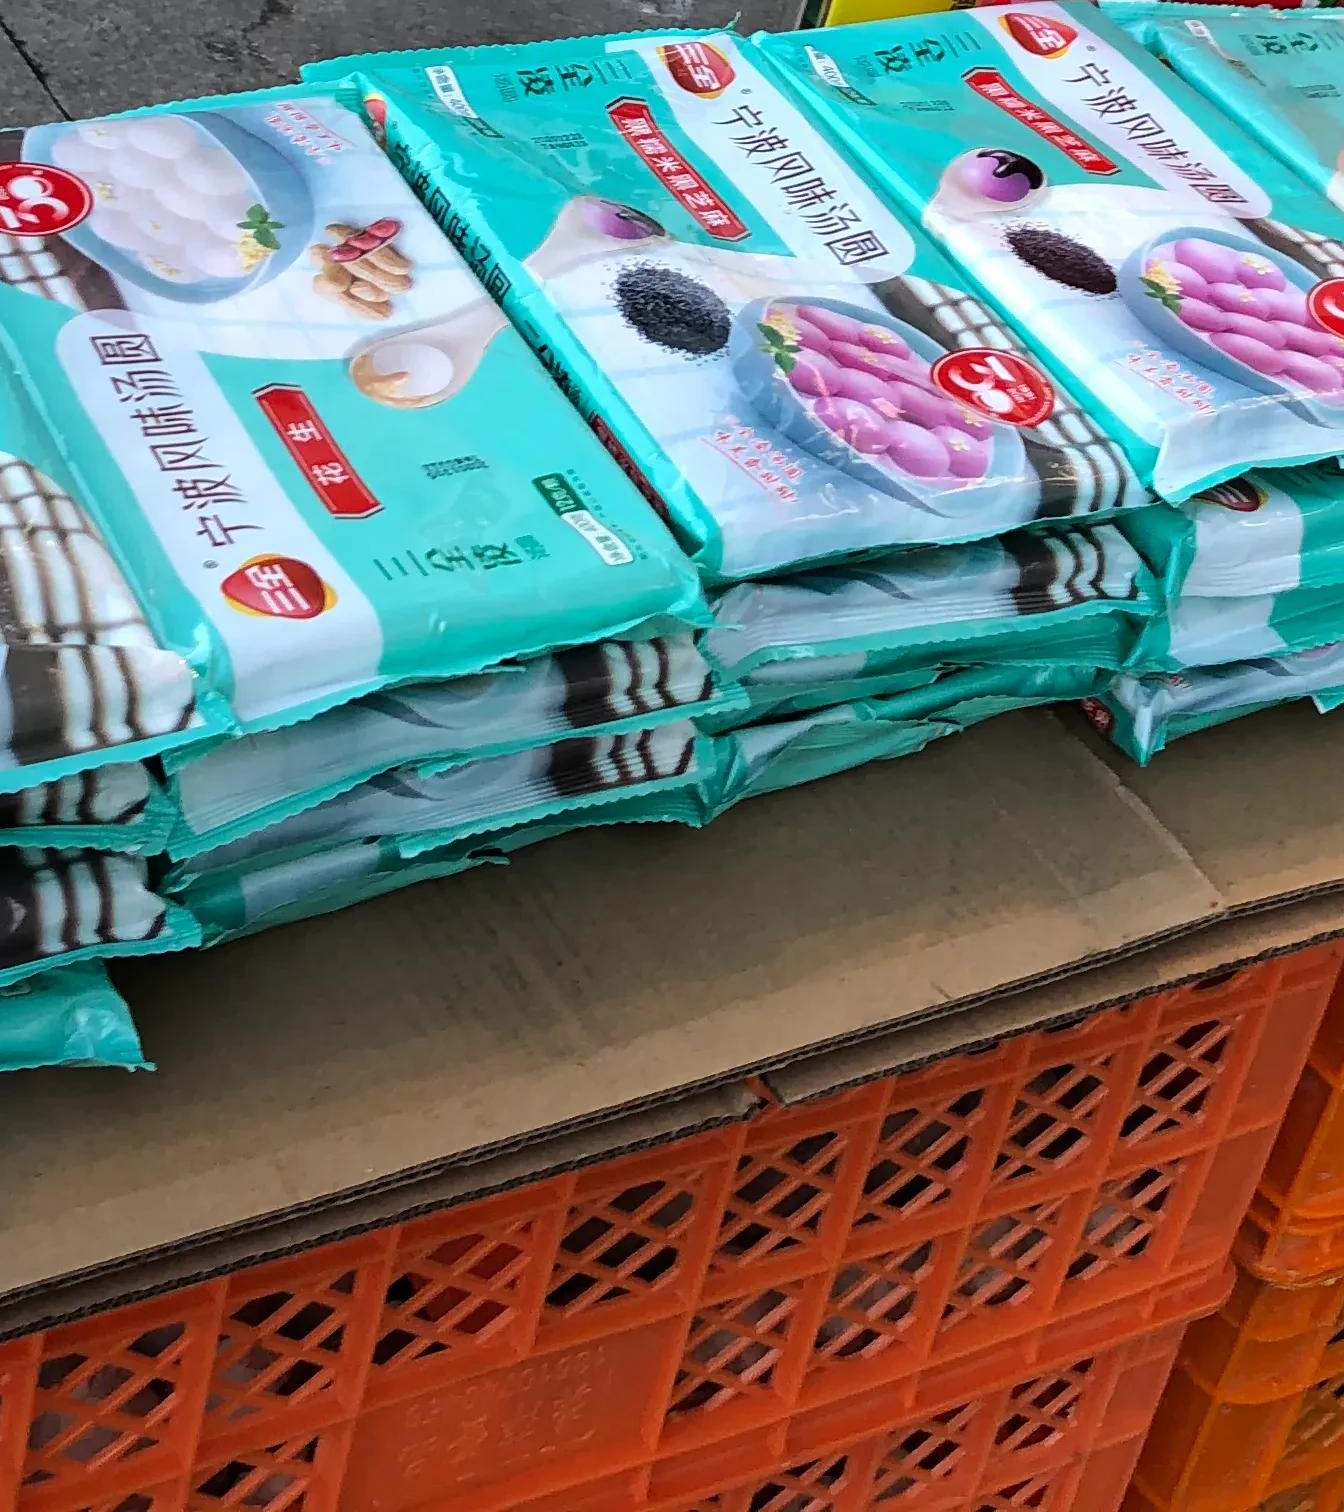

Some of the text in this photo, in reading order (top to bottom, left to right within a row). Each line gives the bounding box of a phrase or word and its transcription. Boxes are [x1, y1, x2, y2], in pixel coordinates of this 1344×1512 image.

[1020, 14, 1068, 54] 三全
[712, 104, 891, 266] 宁波风味汤圆
[1061, 62, 1250, 206] 宁波风味汤圆
[89, 333, 265, 548] 宁波风味汤圆
[286, 418, 351, 488] 花生
[247, 561, 312, 613] 三全
